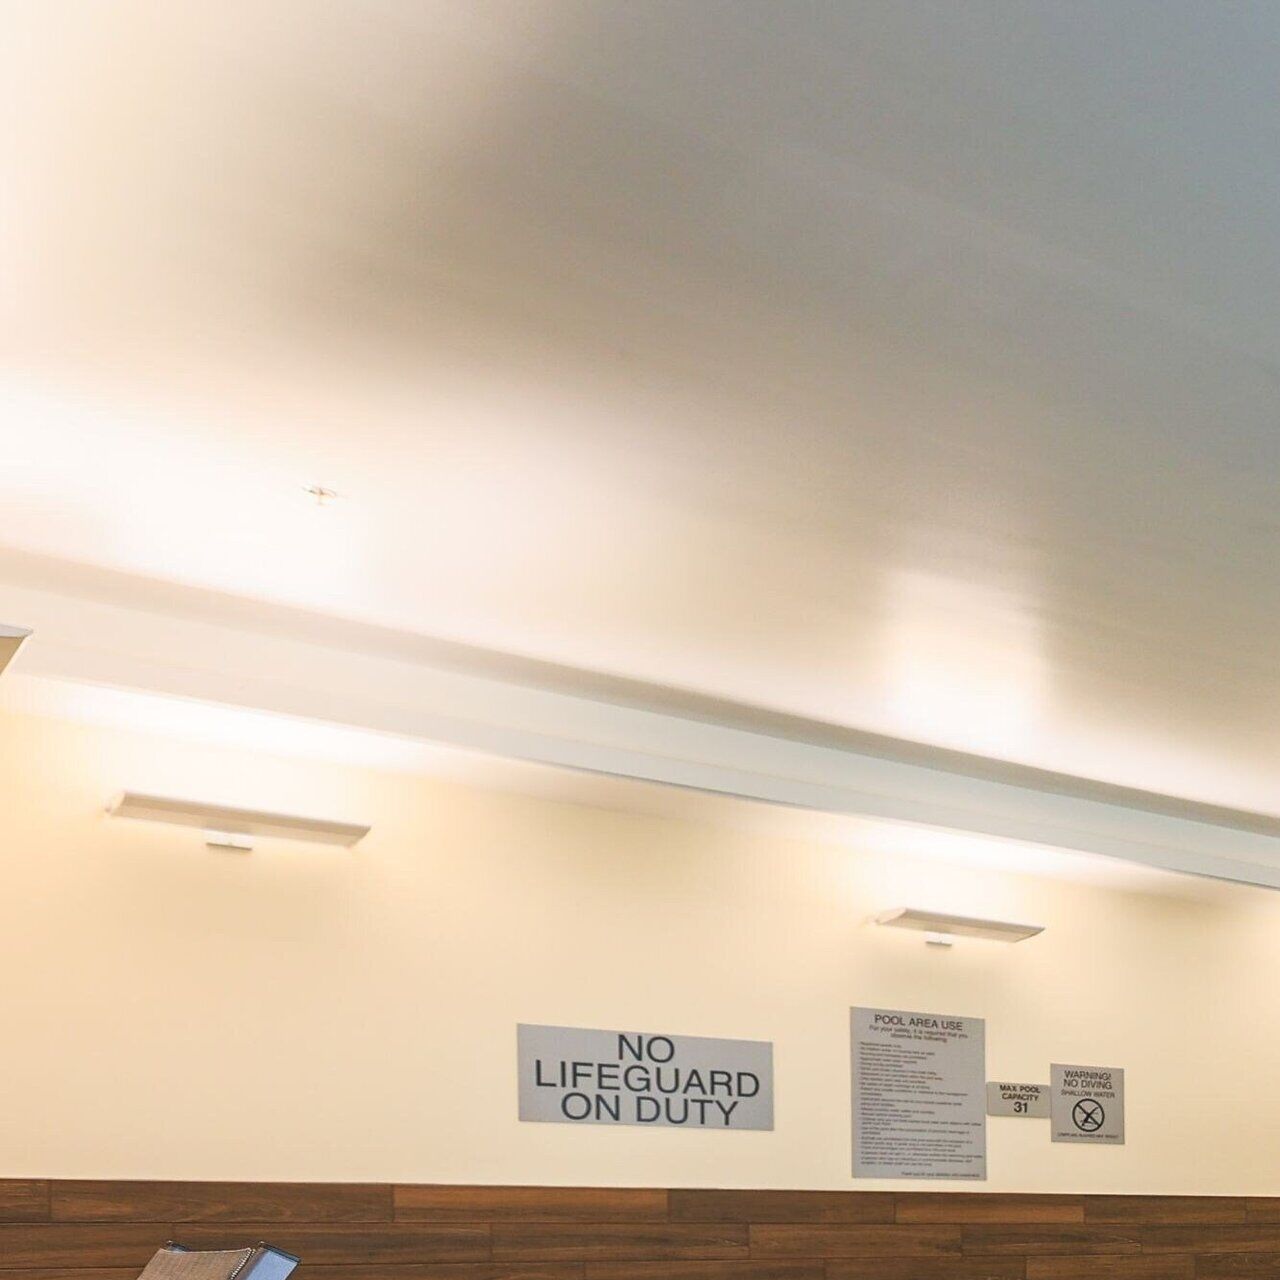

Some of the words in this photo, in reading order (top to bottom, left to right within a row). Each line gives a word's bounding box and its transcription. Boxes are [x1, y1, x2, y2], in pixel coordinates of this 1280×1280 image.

[875, 1013, 907, 1026] POOL
[908, 1017, 938, 1029] AREA
[941, 1020, 964, 1032] USE
[619, 1033, 676, 1064] NO
[535, 1058, 761, 1098] LIFEGUARD
[1064, 1070, 1112, 1082] WARNING!
[1000, 1084, 1018, 1093] MAX
[1019, 1085, 1041, 1094] POOL
[1063, 1078, 1080, 1088] NO
[1081, 1080, 1113, 1090] DIVING
[1001, 1092, 1040, 1102] CAPACITY
[561, 1091, 621, 1121] ON
[636, 1095, 739, 1126] DUTY
[1013, 1101, 1028, 1114] 31
